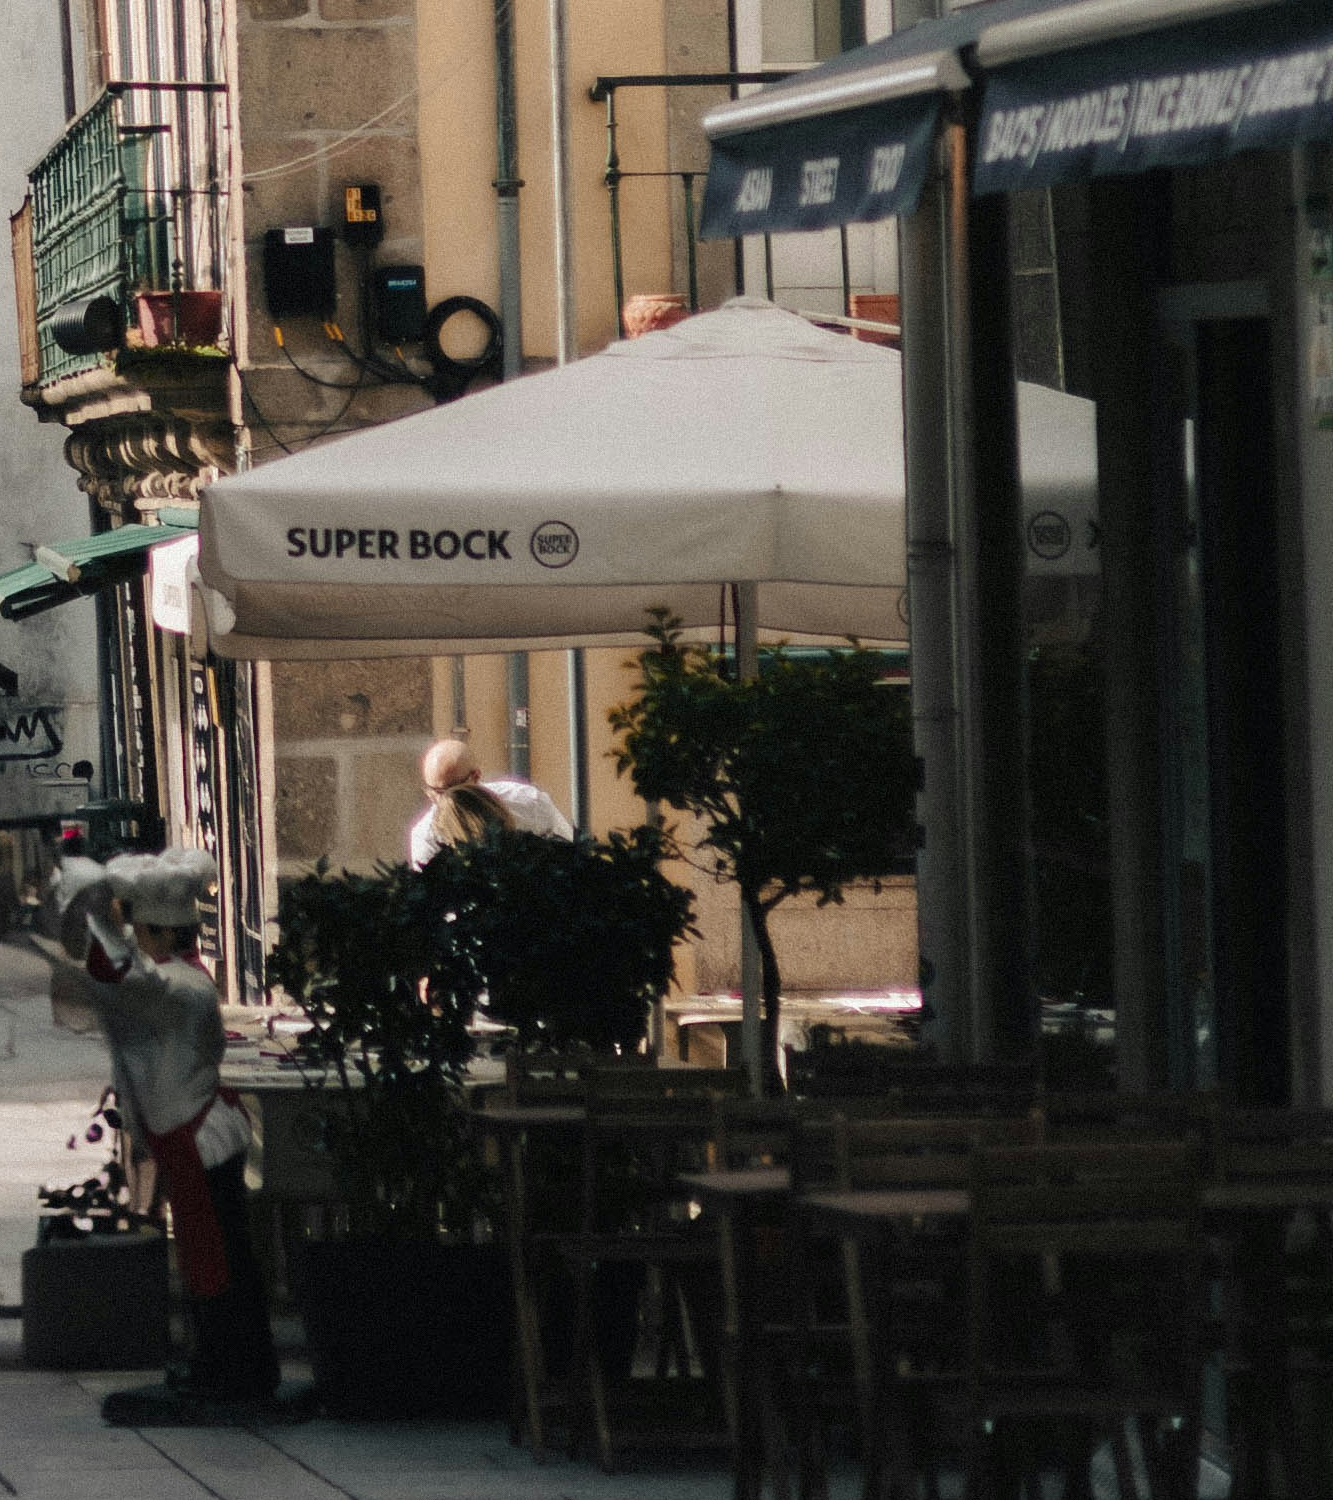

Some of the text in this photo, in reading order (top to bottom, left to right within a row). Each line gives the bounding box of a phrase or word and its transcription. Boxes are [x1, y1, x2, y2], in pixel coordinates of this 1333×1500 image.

[1042, 83, 1129, 152] NOODLES
[797, 156, 840, 207] STREET
[286, 526, 513, 561] SUPER BOCK
[536, 533, 572, 544] SUPER
[538, 543, 571, 554] BOCK
